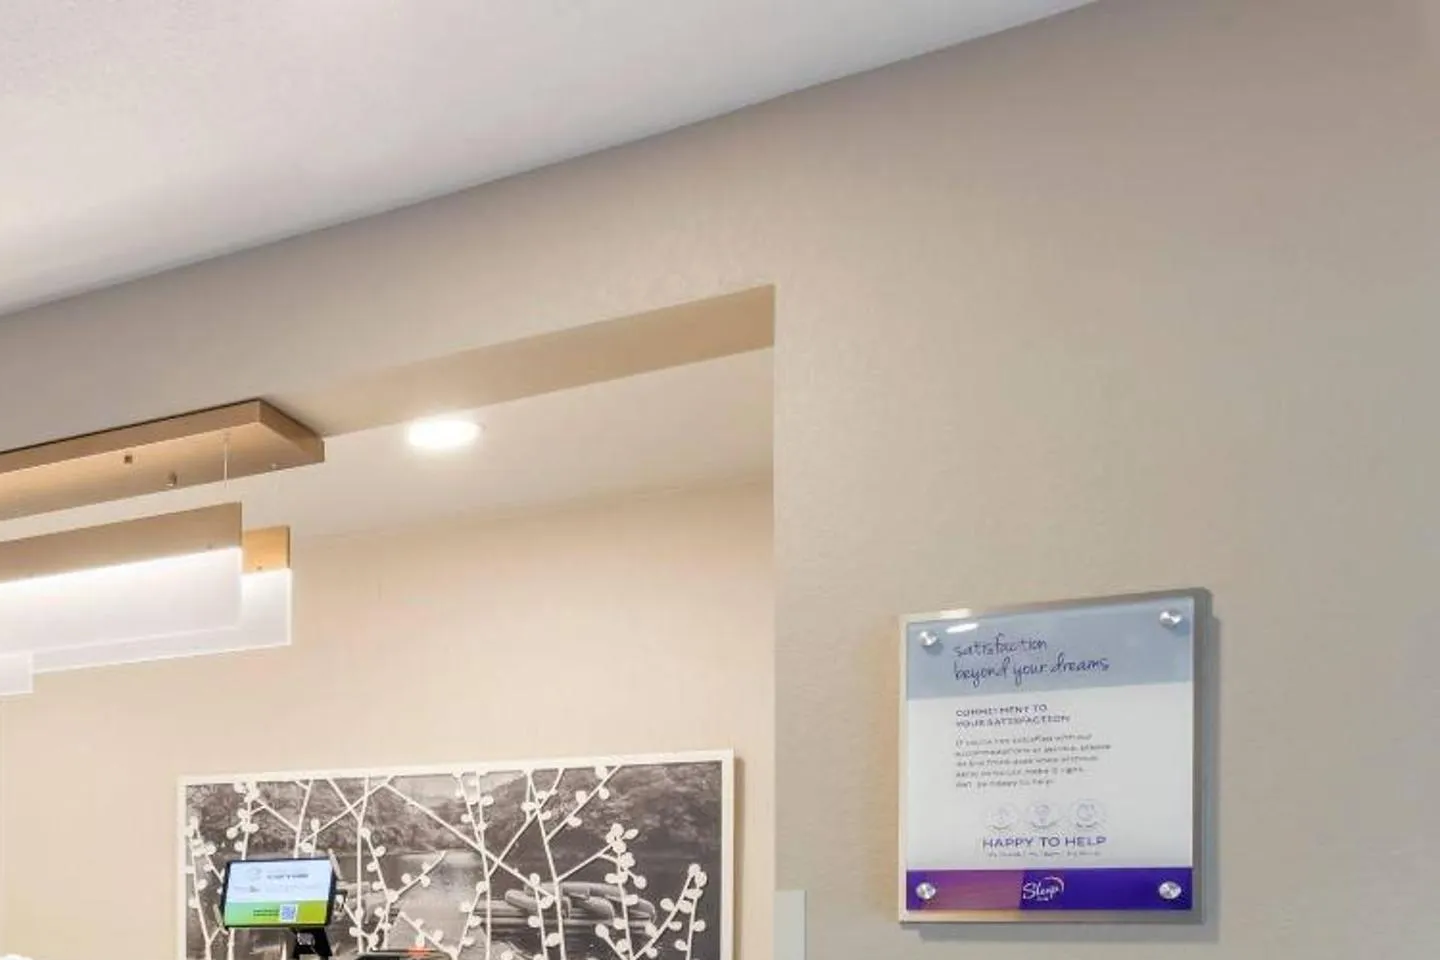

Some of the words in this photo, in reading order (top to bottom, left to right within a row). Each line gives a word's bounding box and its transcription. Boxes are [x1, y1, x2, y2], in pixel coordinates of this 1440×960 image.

[954, 656, 1010, 687] beyond
[1013, 663, 1047, 686] your
[1050, 652, 1109, 674] dreams
[982, 836, 1033, 848] HAPPY
[1040, 836, 1060, 847] TO
[1065, 836, 1106, 847] HELP
